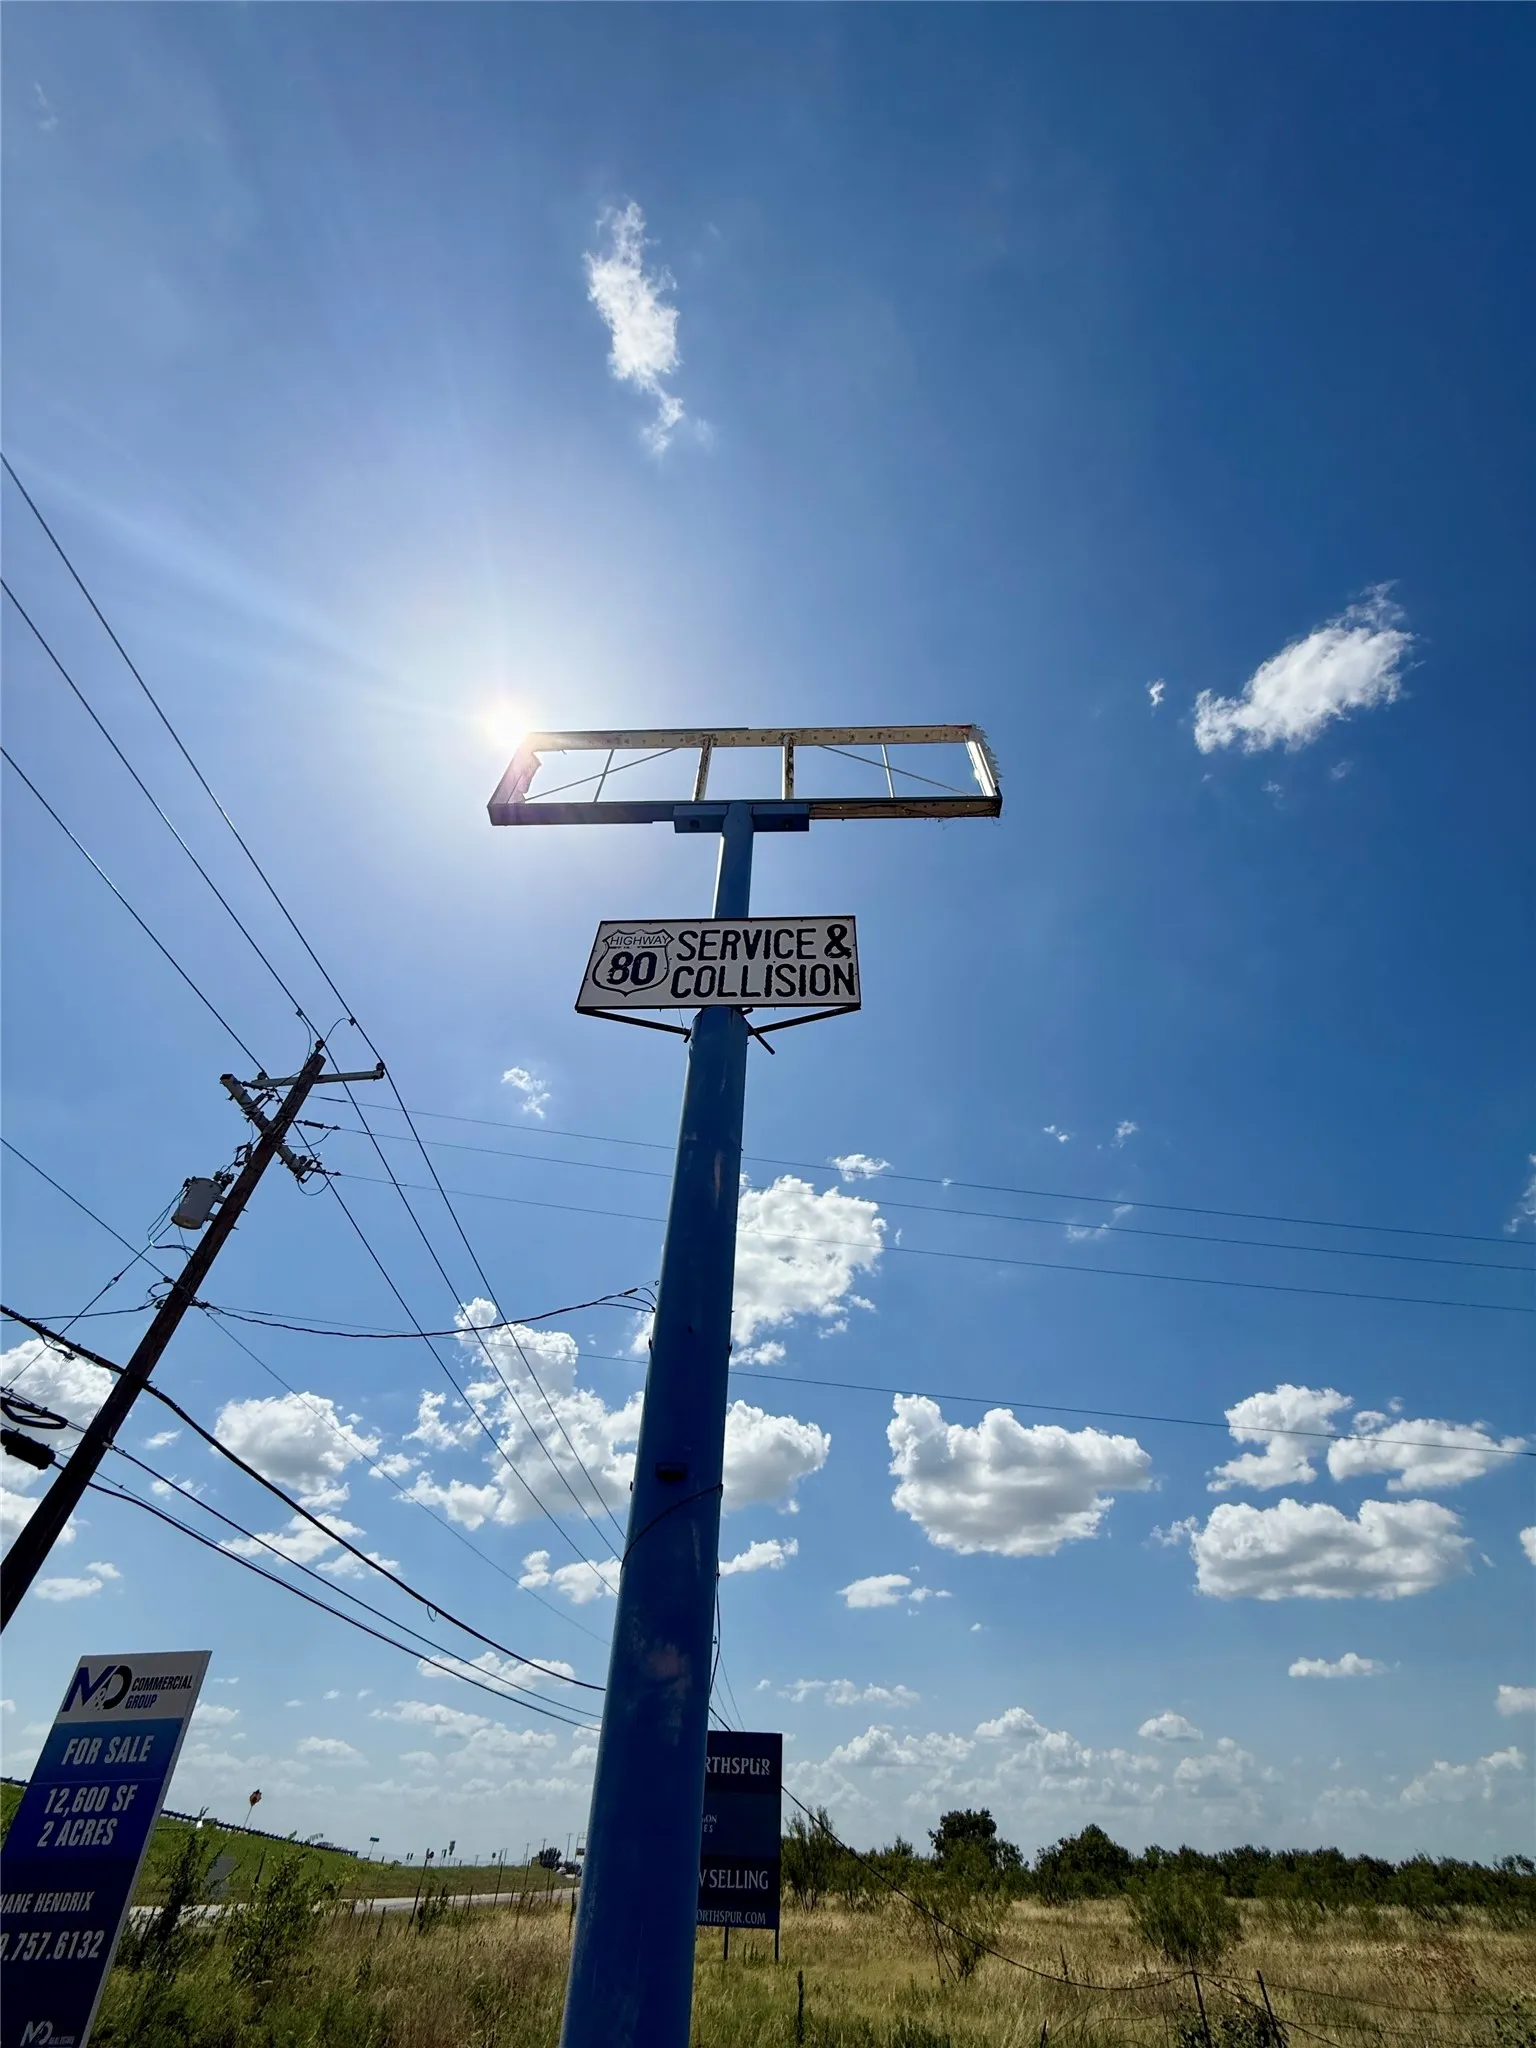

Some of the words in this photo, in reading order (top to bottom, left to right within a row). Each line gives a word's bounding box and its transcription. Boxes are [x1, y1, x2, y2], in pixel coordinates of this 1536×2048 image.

[610, 935, 669, 946] HIGHWAY
[676, 928, 817, 961] SERVICE
[824, 924, 852, 960] &
[607, 951, 658, 985] 80
[670, 963, 856, 998] COLLISION
[131, 1675, 193, 1691] COMMERCIAL
[125, 1694, 158, 1709] GROUP
[61, 1737, 103, 1766] FOR
[104, 1735, 155, 1764] SALE
[44, 1786, 110, 1817] 12,600
[111, 1784, 139, 1812] SF
[36, 1820, 54, 1847] 2
[54, 1818, 118, 1847] ACRES
[709, 1869, 769, 1890] SELLING
[33, 1891, 95, 1913] HENDRIX
